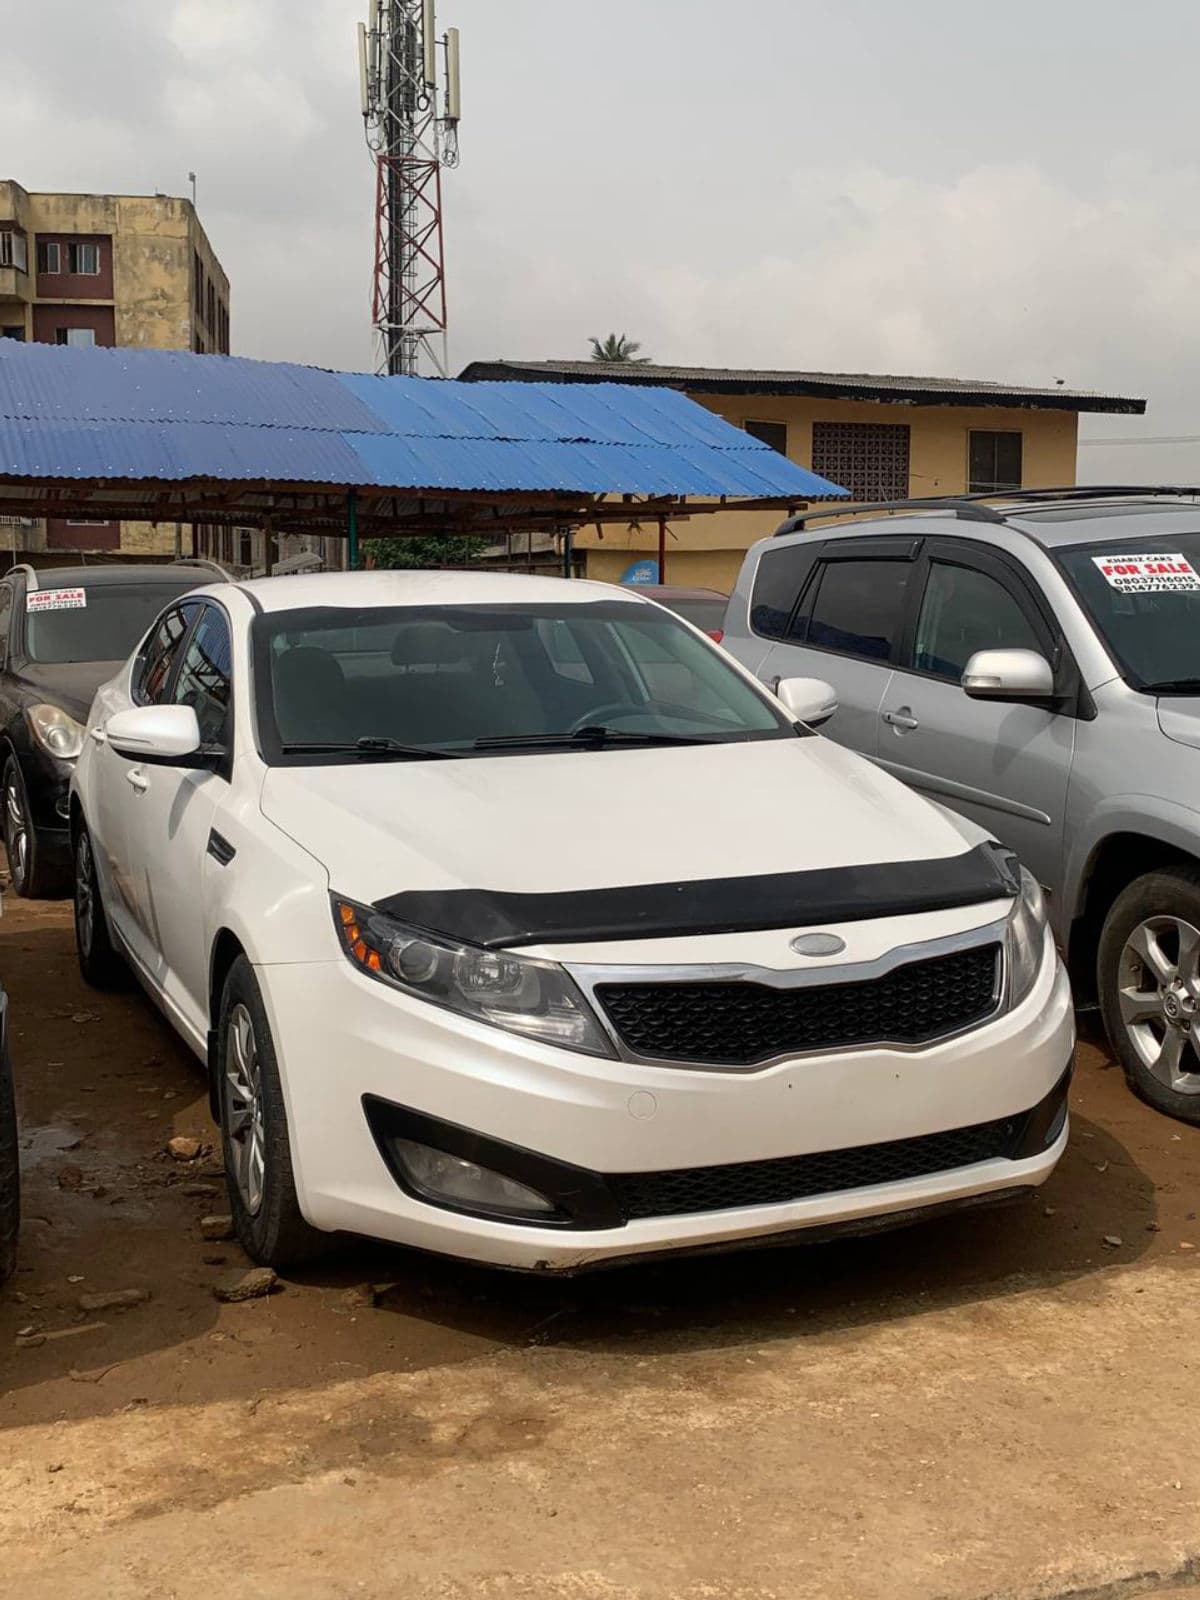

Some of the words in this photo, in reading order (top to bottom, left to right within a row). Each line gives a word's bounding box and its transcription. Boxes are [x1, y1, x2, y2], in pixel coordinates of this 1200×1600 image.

[1101, 564, 1142, 576] FOR
[1144, 563, 1193, 574] SALE
[29, 595, 51, 603] FOR
[55, 592, 83, 600] SALE
